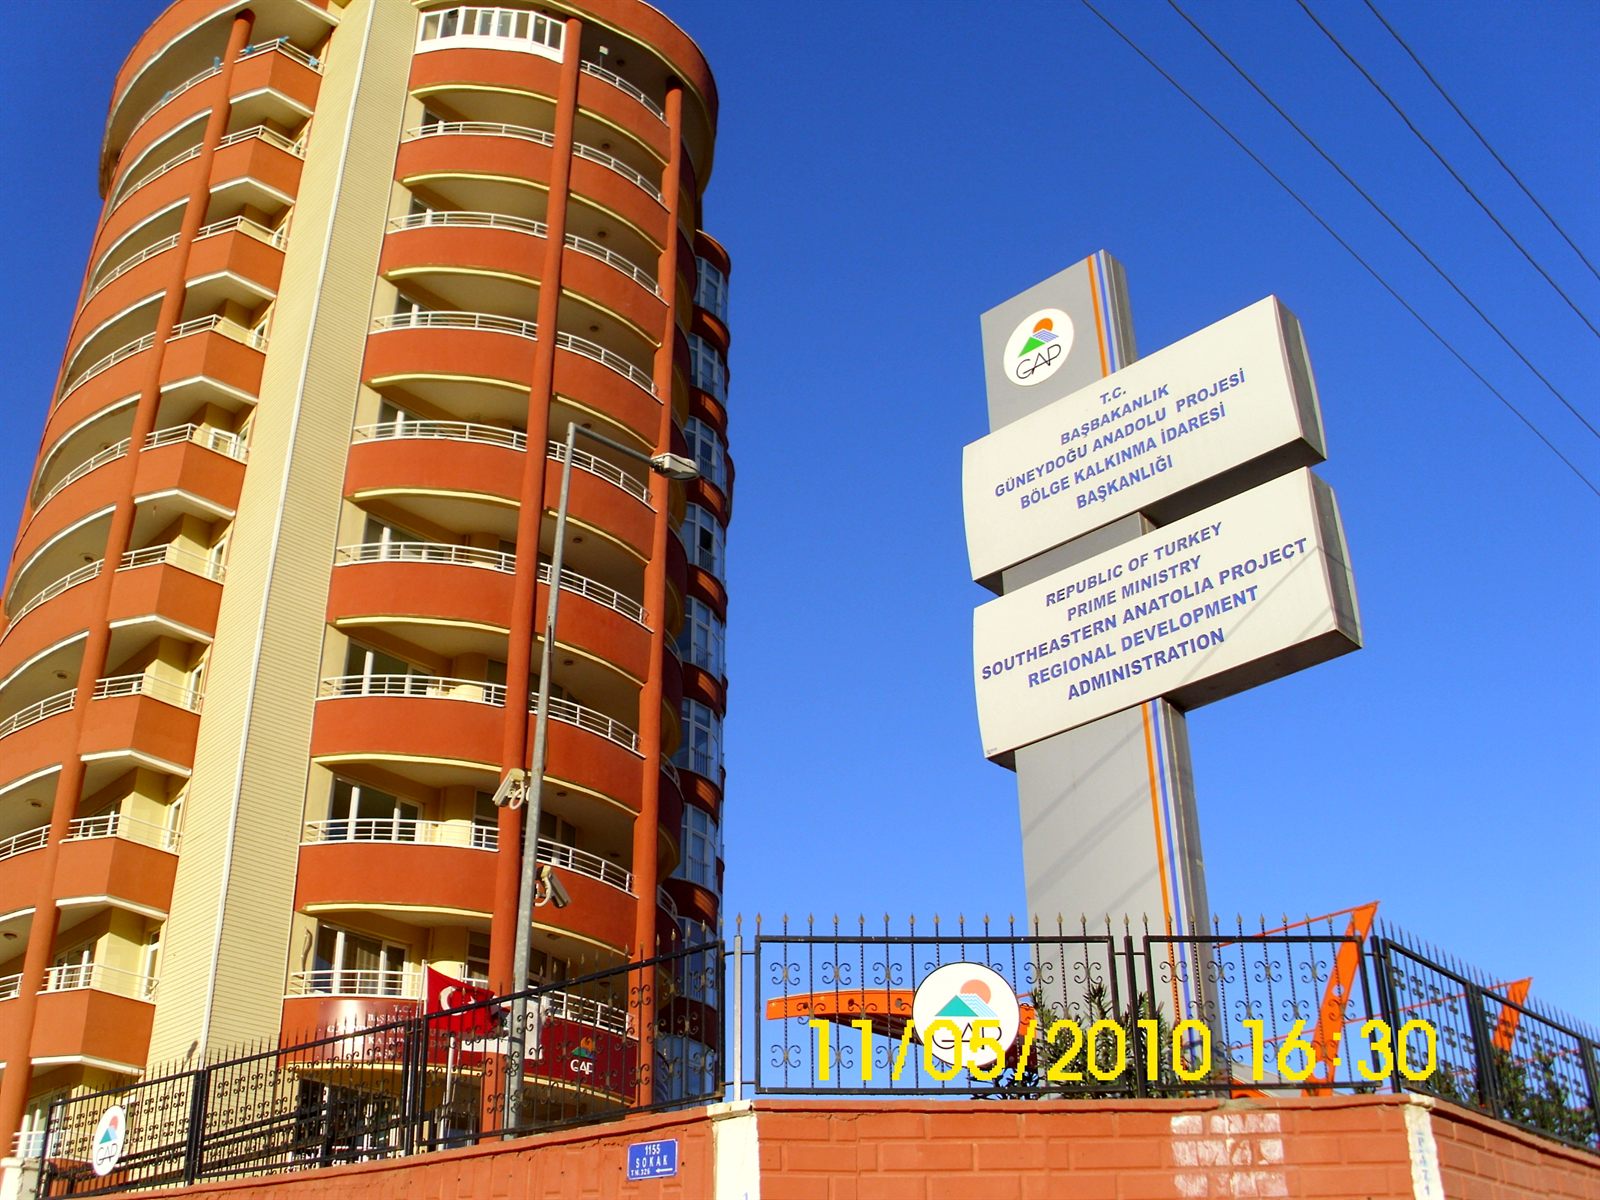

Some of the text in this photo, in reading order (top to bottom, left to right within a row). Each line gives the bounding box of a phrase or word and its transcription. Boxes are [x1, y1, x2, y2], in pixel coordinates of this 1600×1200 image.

[1016, 343, 1062, 379] GAP
[1060, 384, 1170, 446] BAŞBAKANLIK
[1100, 387, 1126, 404] T.C.
[995, 367, 1245, 498] GÜNEYDOĞU ANADOLU PROJESİ
[1020, 402, 1226, 510] BÖLGE KALKINMA İDARESİ
[1077, 454, 1174, 510] BAŞKANLIĞI
[1046, 522, 1222, 607] REPUBLIC OF TURKEY
[1067, 555, 1201, 621] PRIME MINISTRY
[982, 538, 1307, 680] SOUTHEASTERN ANATOLIA PROJECT
[1028, 585, 1258, 688] REGIONAL DEVELOPMENT
[1067, 628, 1225, 700] ADMINISTRATION
[635, 1155, 668, 1169] SOKAK
[645, 1143, 660, 1156] 1155
